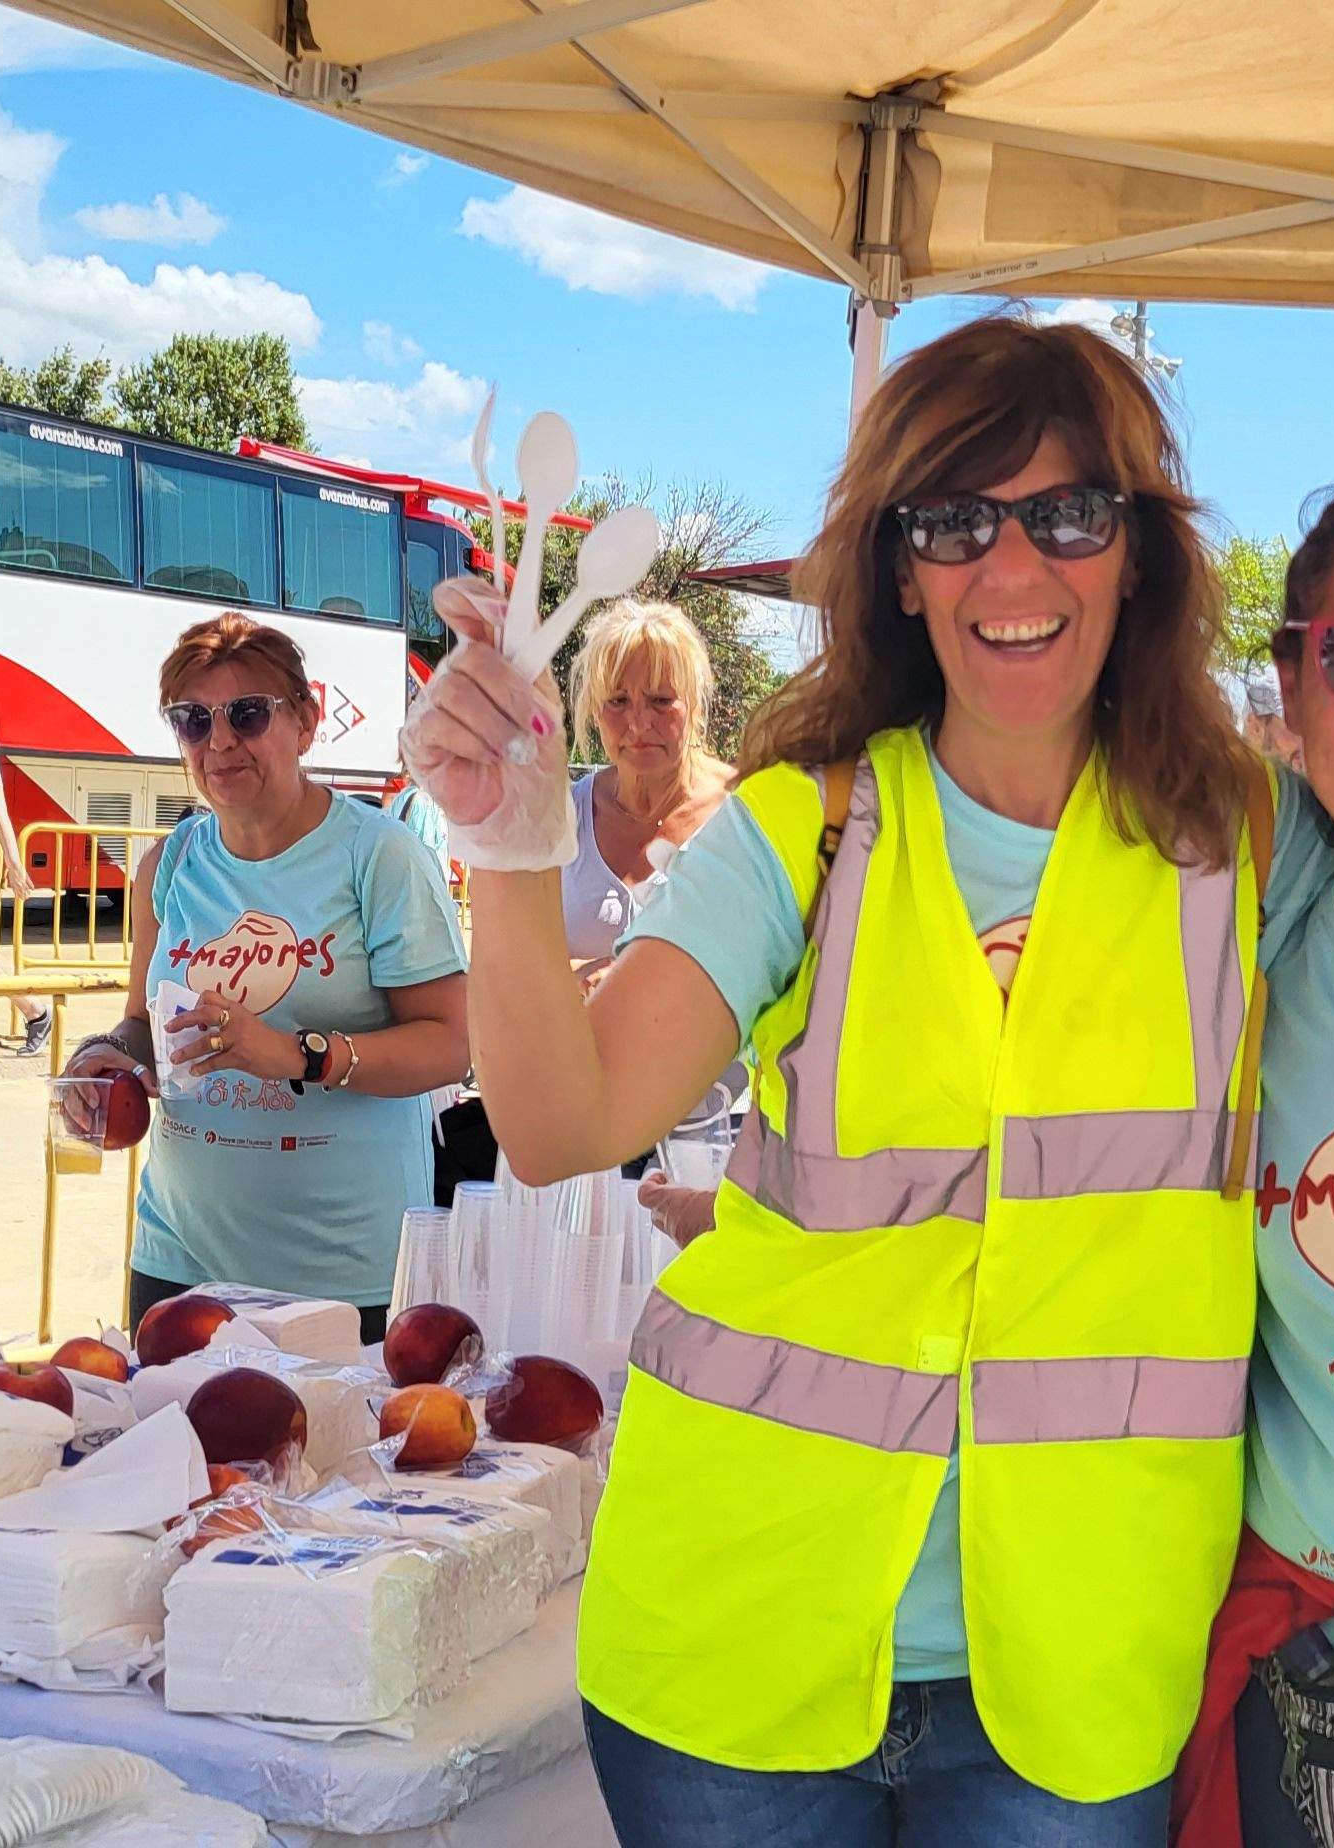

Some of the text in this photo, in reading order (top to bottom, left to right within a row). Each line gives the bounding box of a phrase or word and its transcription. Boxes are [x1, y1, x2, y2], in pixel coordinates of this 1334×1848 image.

[29, 423, 123, 457] avanzabus.com
[319, 487, 390, 514] avanzabus.com
[169, 933, 335, 990] +mayores
